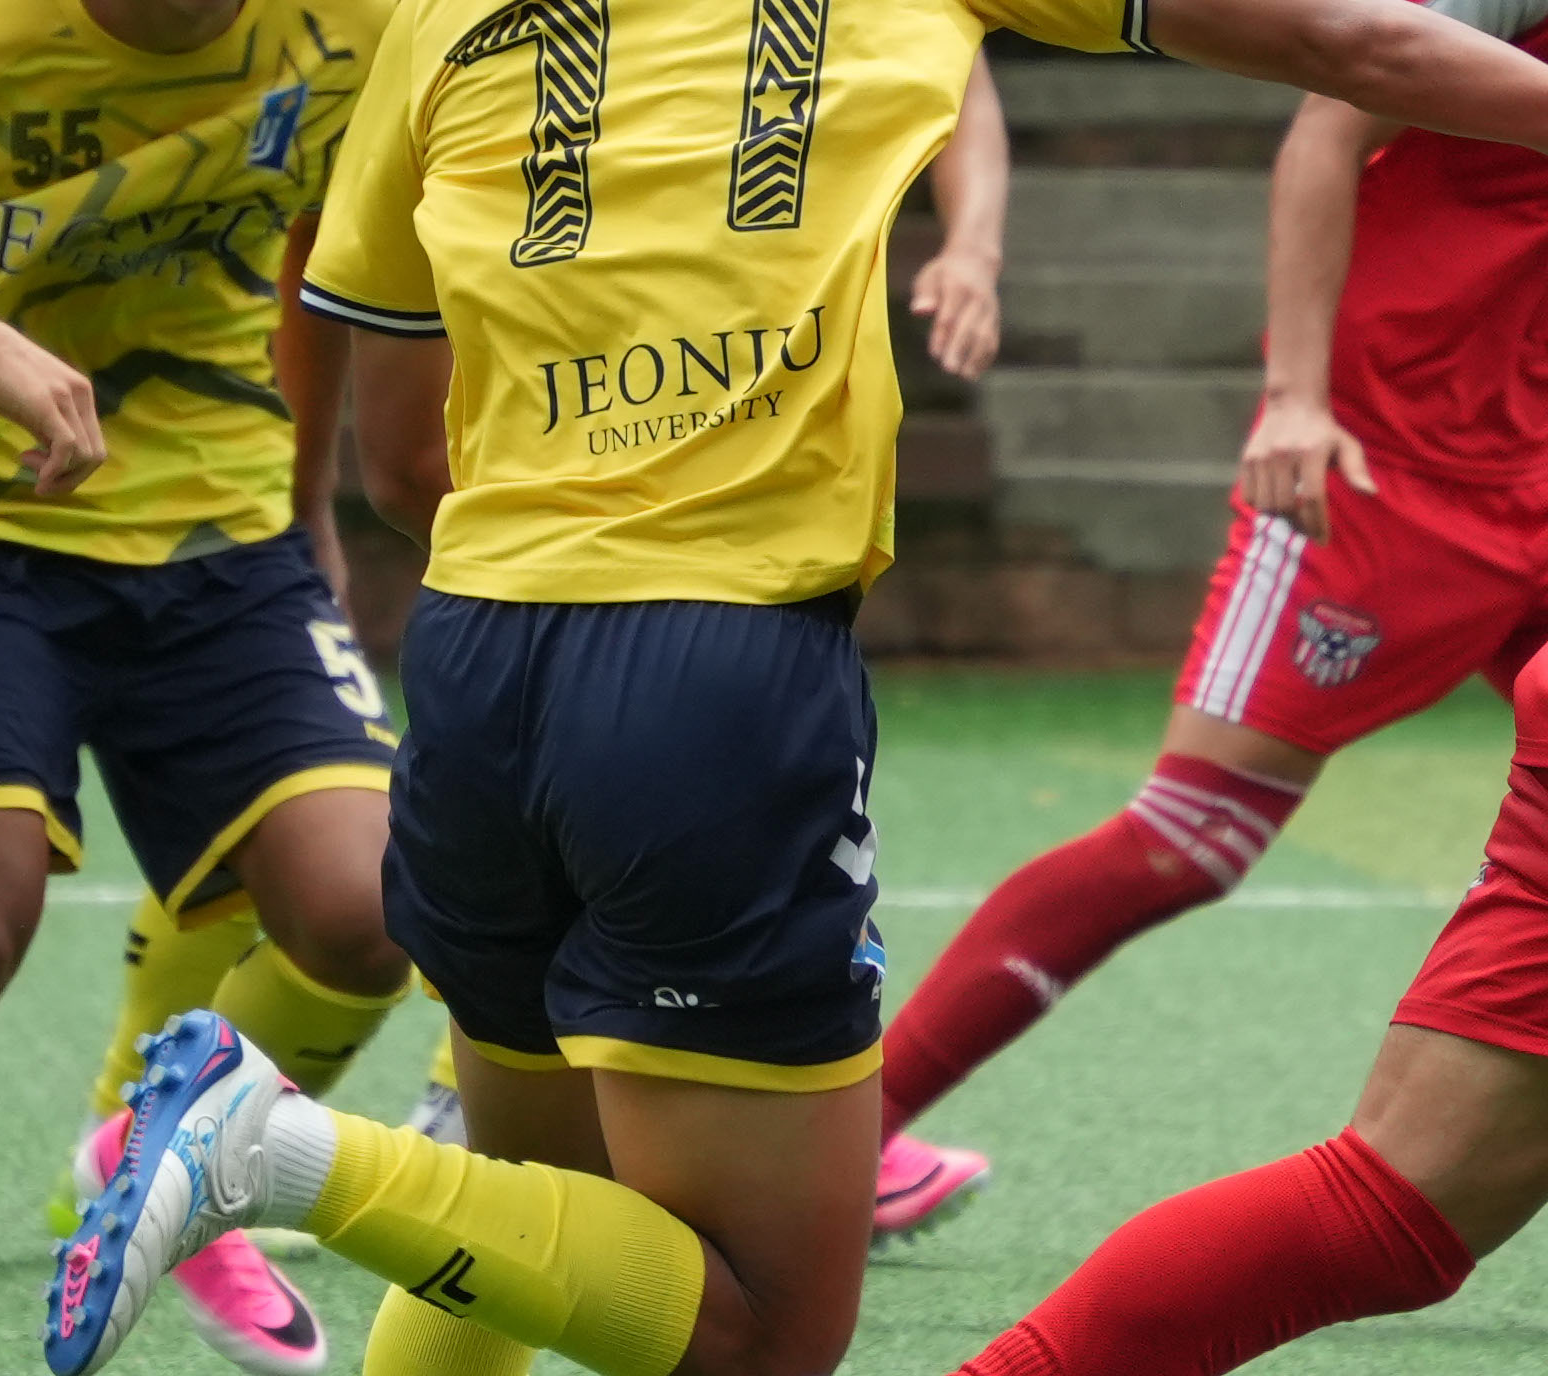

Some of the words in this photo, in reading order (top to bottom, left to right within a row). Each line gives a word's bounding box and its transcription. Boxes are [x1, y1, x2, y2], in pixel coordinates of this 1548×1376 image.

[9, 107, 102, 188] 55
[537, 305, 829, 436] JEONJU
[587, 390, 785, 457] UNIVERSITY
